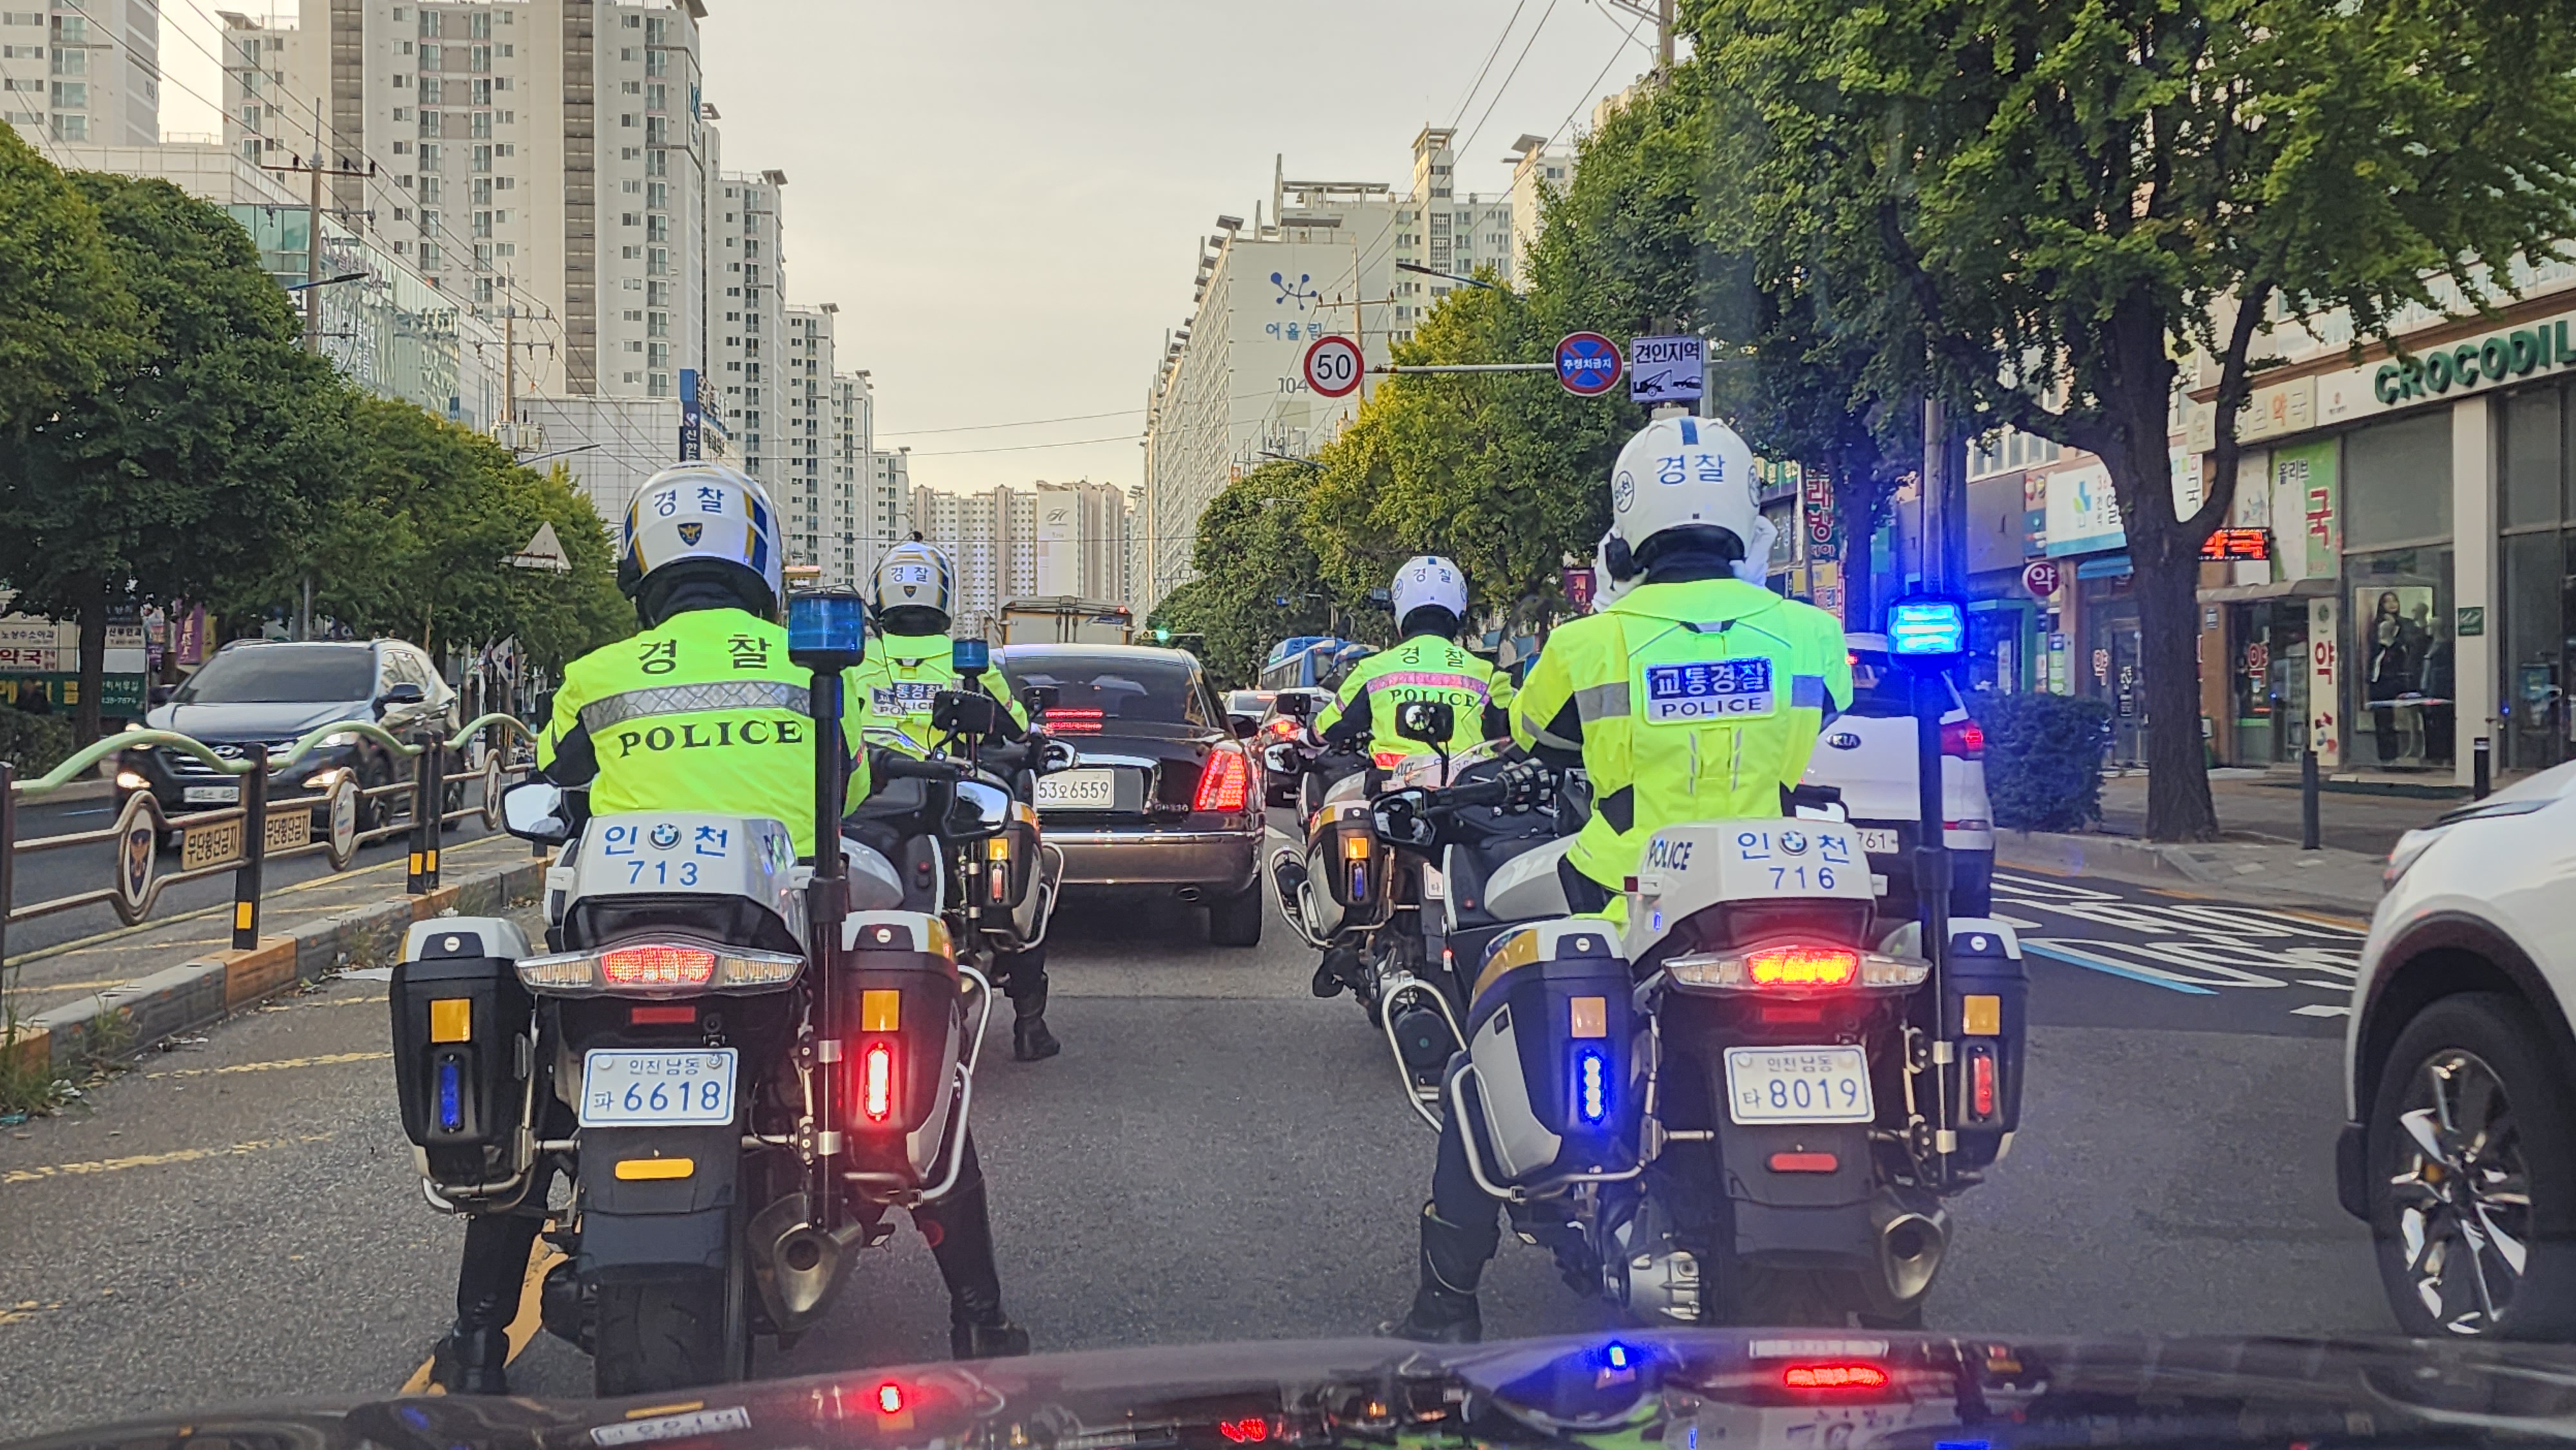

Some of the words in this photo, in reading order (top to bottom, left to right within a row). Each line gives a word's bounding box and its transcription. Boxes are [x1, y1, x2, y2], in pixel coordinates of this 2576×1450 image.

[1564, 359, 1611, 370] 주정차금지
[1635, 342, 1700, 364] 견인지역
[1317, 354, 1351, 380] 50
[1656, 454, 1726, 485] 경찰
[2278, 460, 2310, 485] 올리브
[654, 487, 724, 516] 경찰
[1806, 467, 1834, 542] 래방
[891, 566, 929, 583] 경찰
[1414, 567, 1452, 583] 경찰
[2031, 567, 2056, 592] 약
[0, 648, 42, 665] 약국
[638, 634, 772, 674] 경찰
[1400, 646, 1464, 668] 경찰
[2315, 641, 2335, 684] 약
[1652, 662, 1765, 695] 교통경찰
[1389, 689, 1475, 707] POLICE
[1662, 697, 1762, 717] POLICE
[618, 720, 803, 759] POLICE
[1833, 735, 1857, 746] KIA
[1038, 780, 1109, 799] 53오6559
[266, 814, 308, 846] 무단횡단금지
[187, 826, 237, 864] 무단횡단금지
[1647, 840, 1693, 871] POLICE
[627, 860, 698, 886] 713
[1769, 866, 1835, 890] 716
